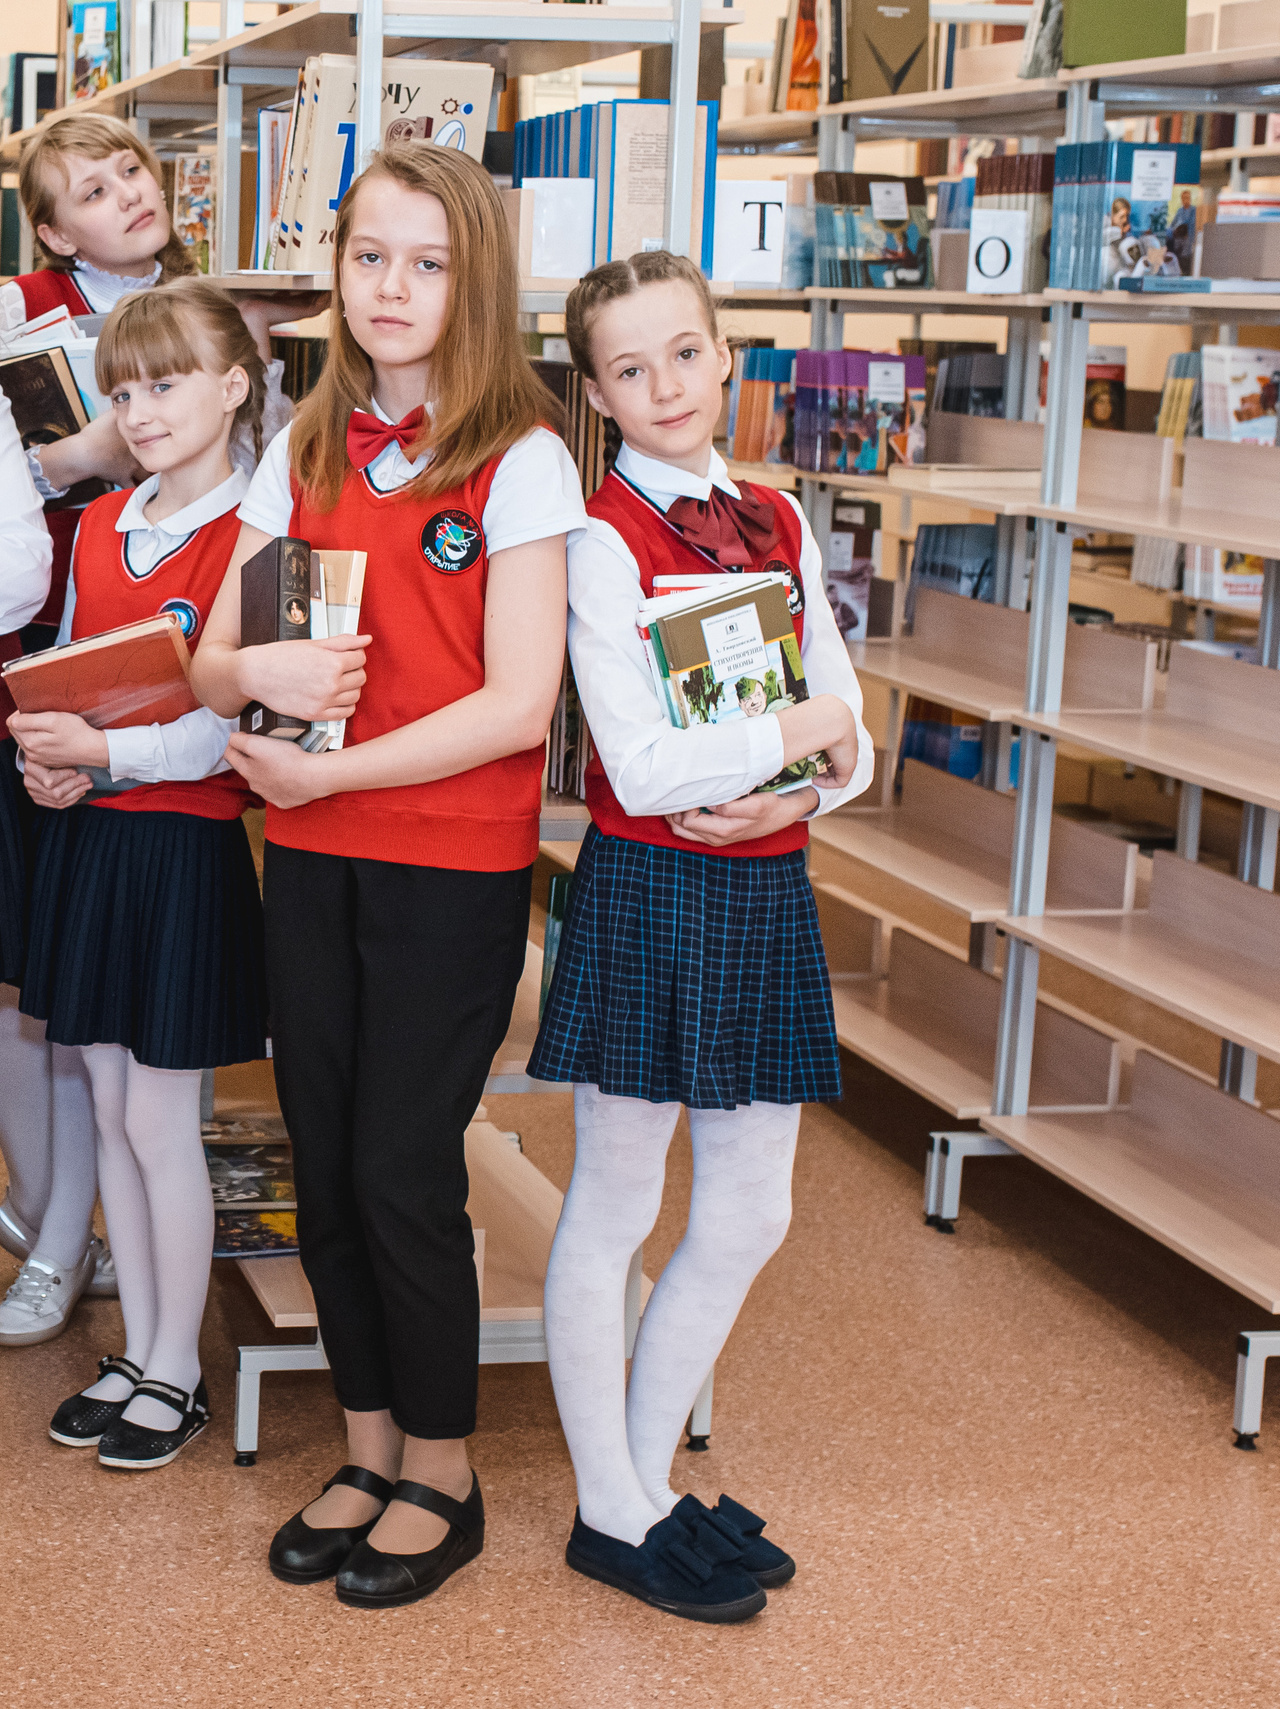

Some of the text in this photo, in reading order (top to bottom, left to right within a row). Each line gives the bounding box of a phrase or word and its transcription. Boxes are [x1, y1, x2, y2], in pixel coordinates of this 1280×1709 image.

[742, 200, 783, 252] Т
[974, 235, 1012, 279] О
[713, 645, 764, 667] СТИХОТВОРЕНИЯ
